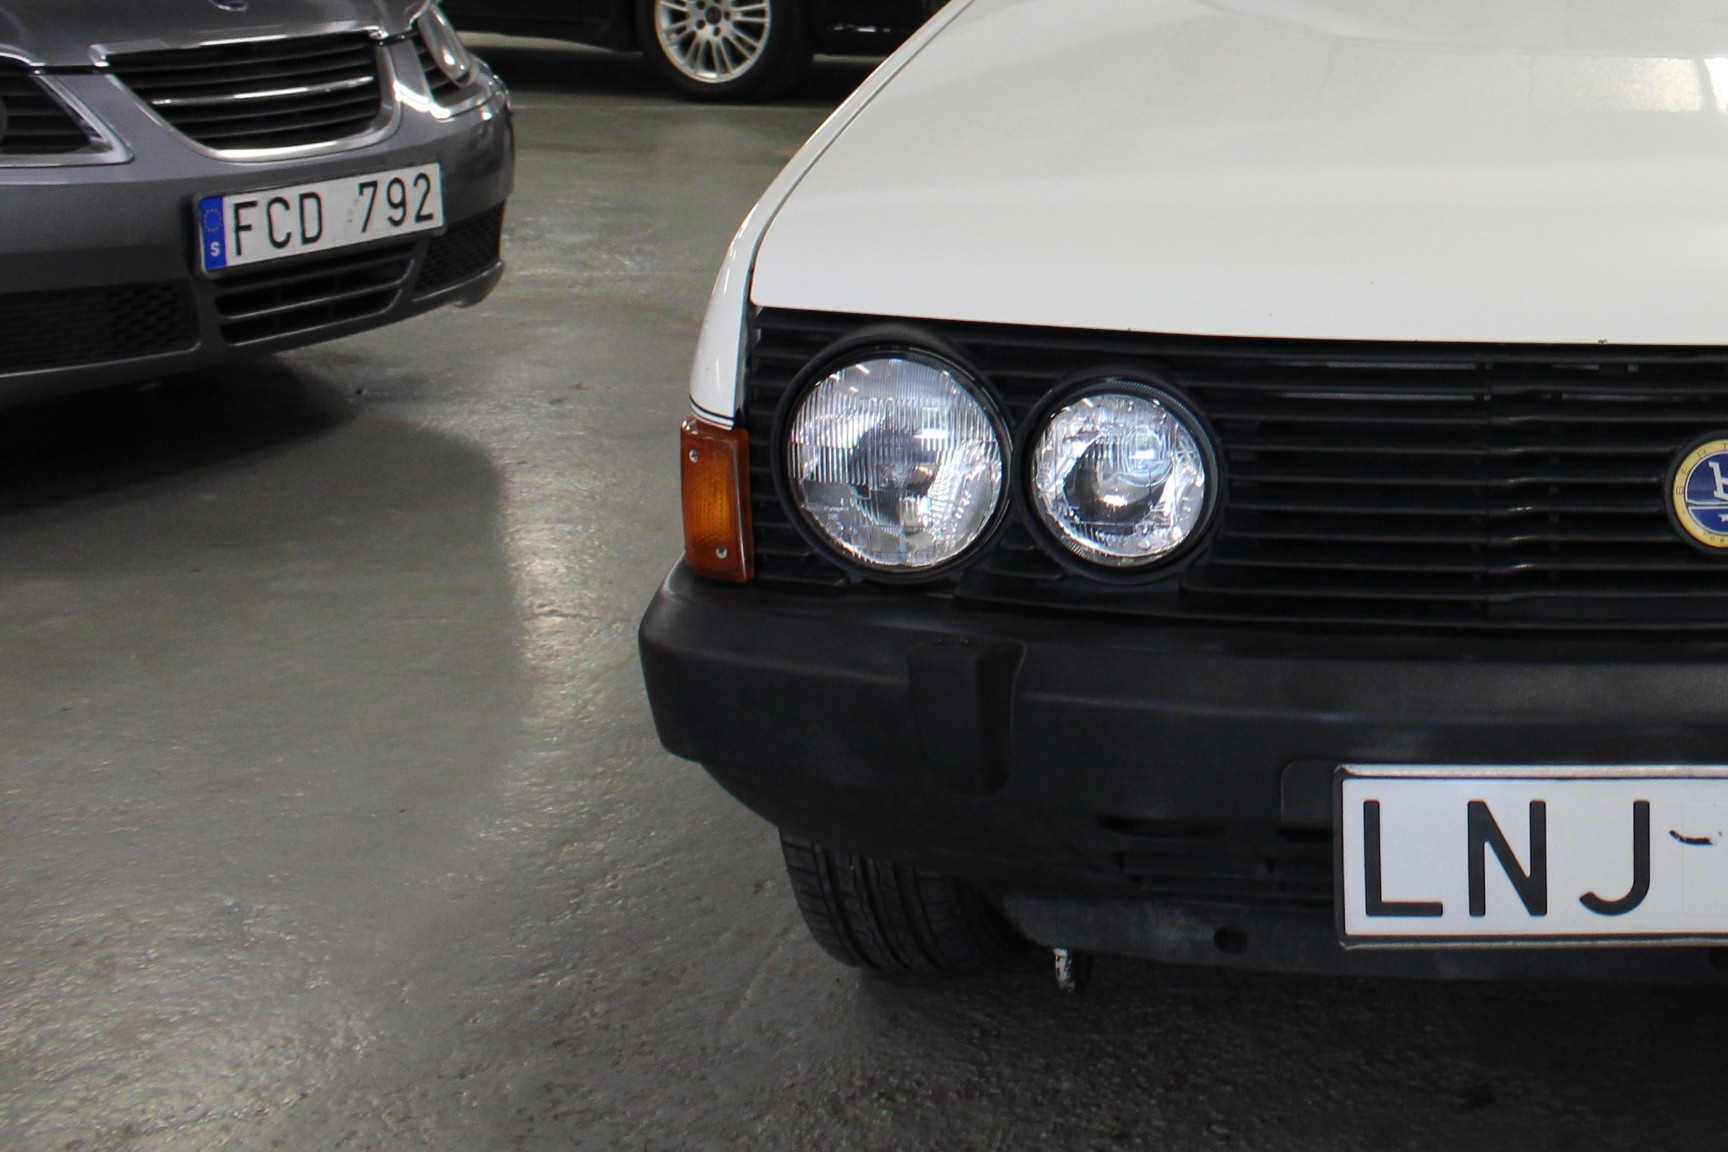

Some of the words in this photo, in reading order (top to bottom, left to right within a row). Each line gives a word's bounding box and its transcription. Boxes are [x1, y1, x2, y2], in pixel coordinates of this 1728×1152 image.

[210, 241, 221, 257] S
[233, 191, 324, 256] FCD
[358, 172, 435, 234] 792
[1363, 799, 1651, 917] LNJ
